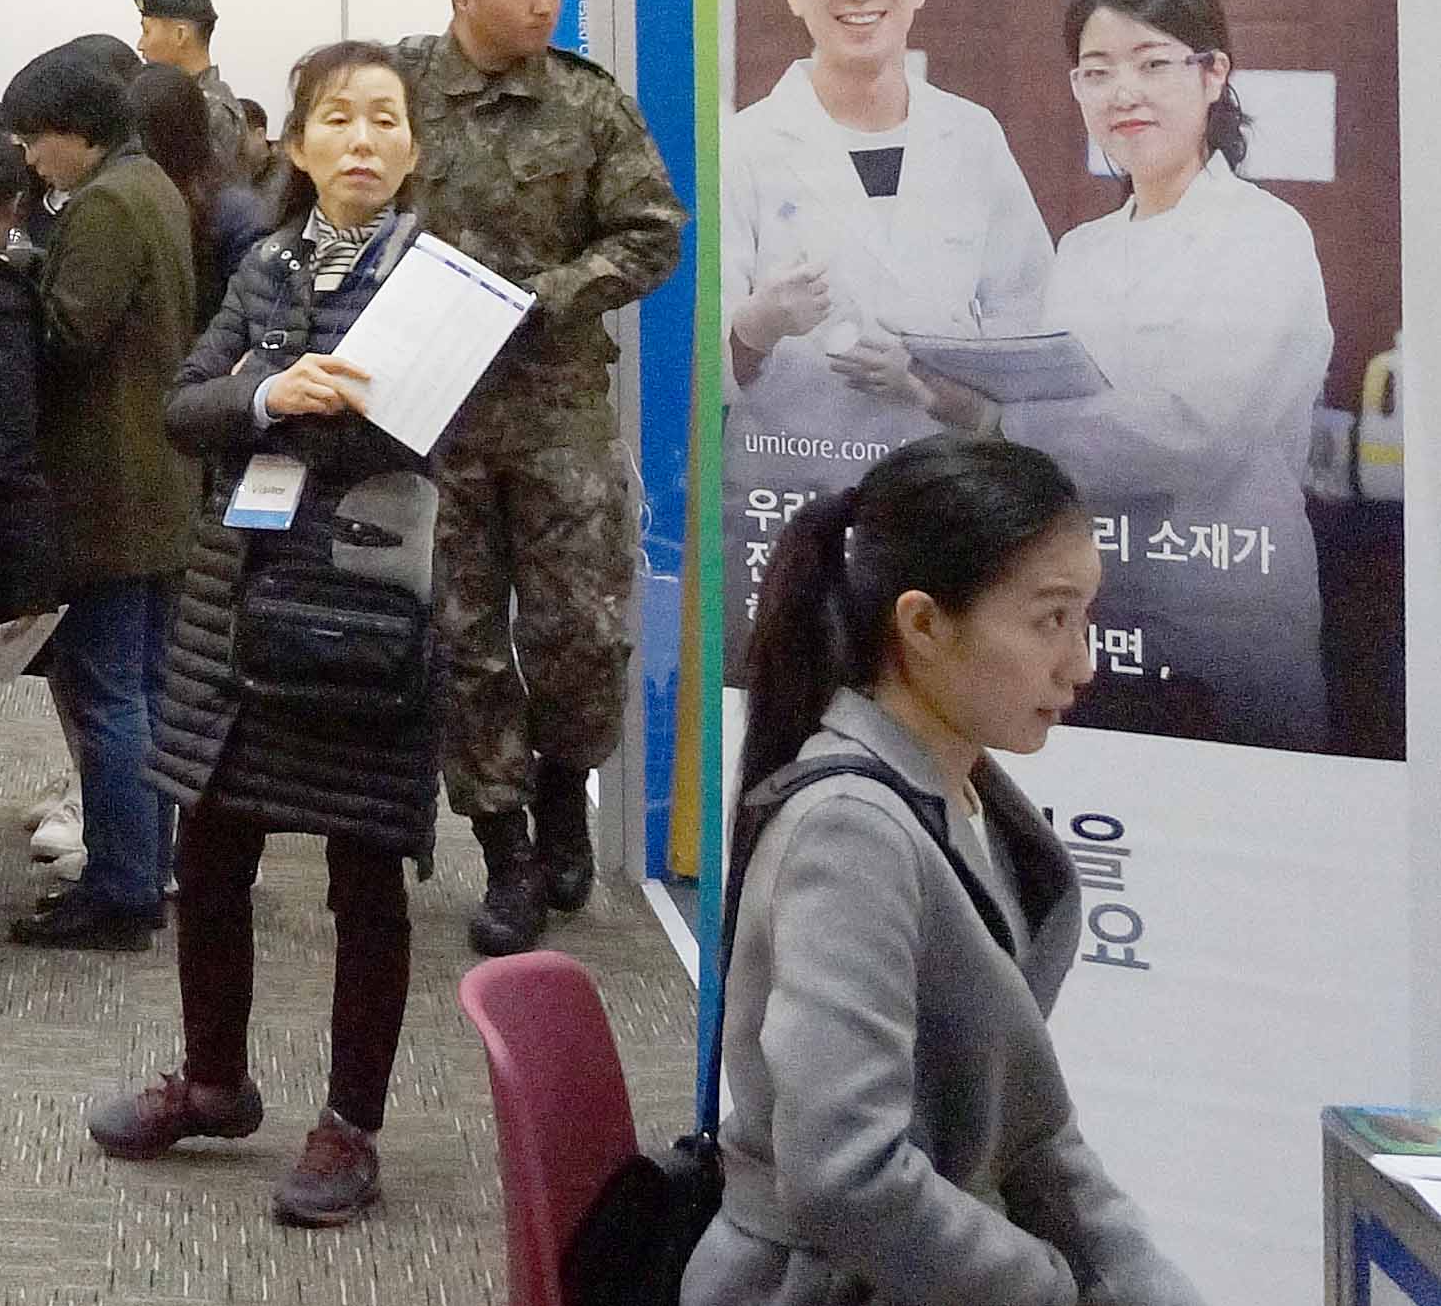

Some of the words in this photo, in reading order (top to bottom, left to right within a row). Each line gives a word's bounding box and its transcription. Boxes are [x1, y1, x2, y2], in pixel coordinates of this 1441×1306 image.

[745, 431, 889, 460] umicore.com
[1146, 520, 1276, 574] 소재가
[1081, 902, 1151, 971] 요
